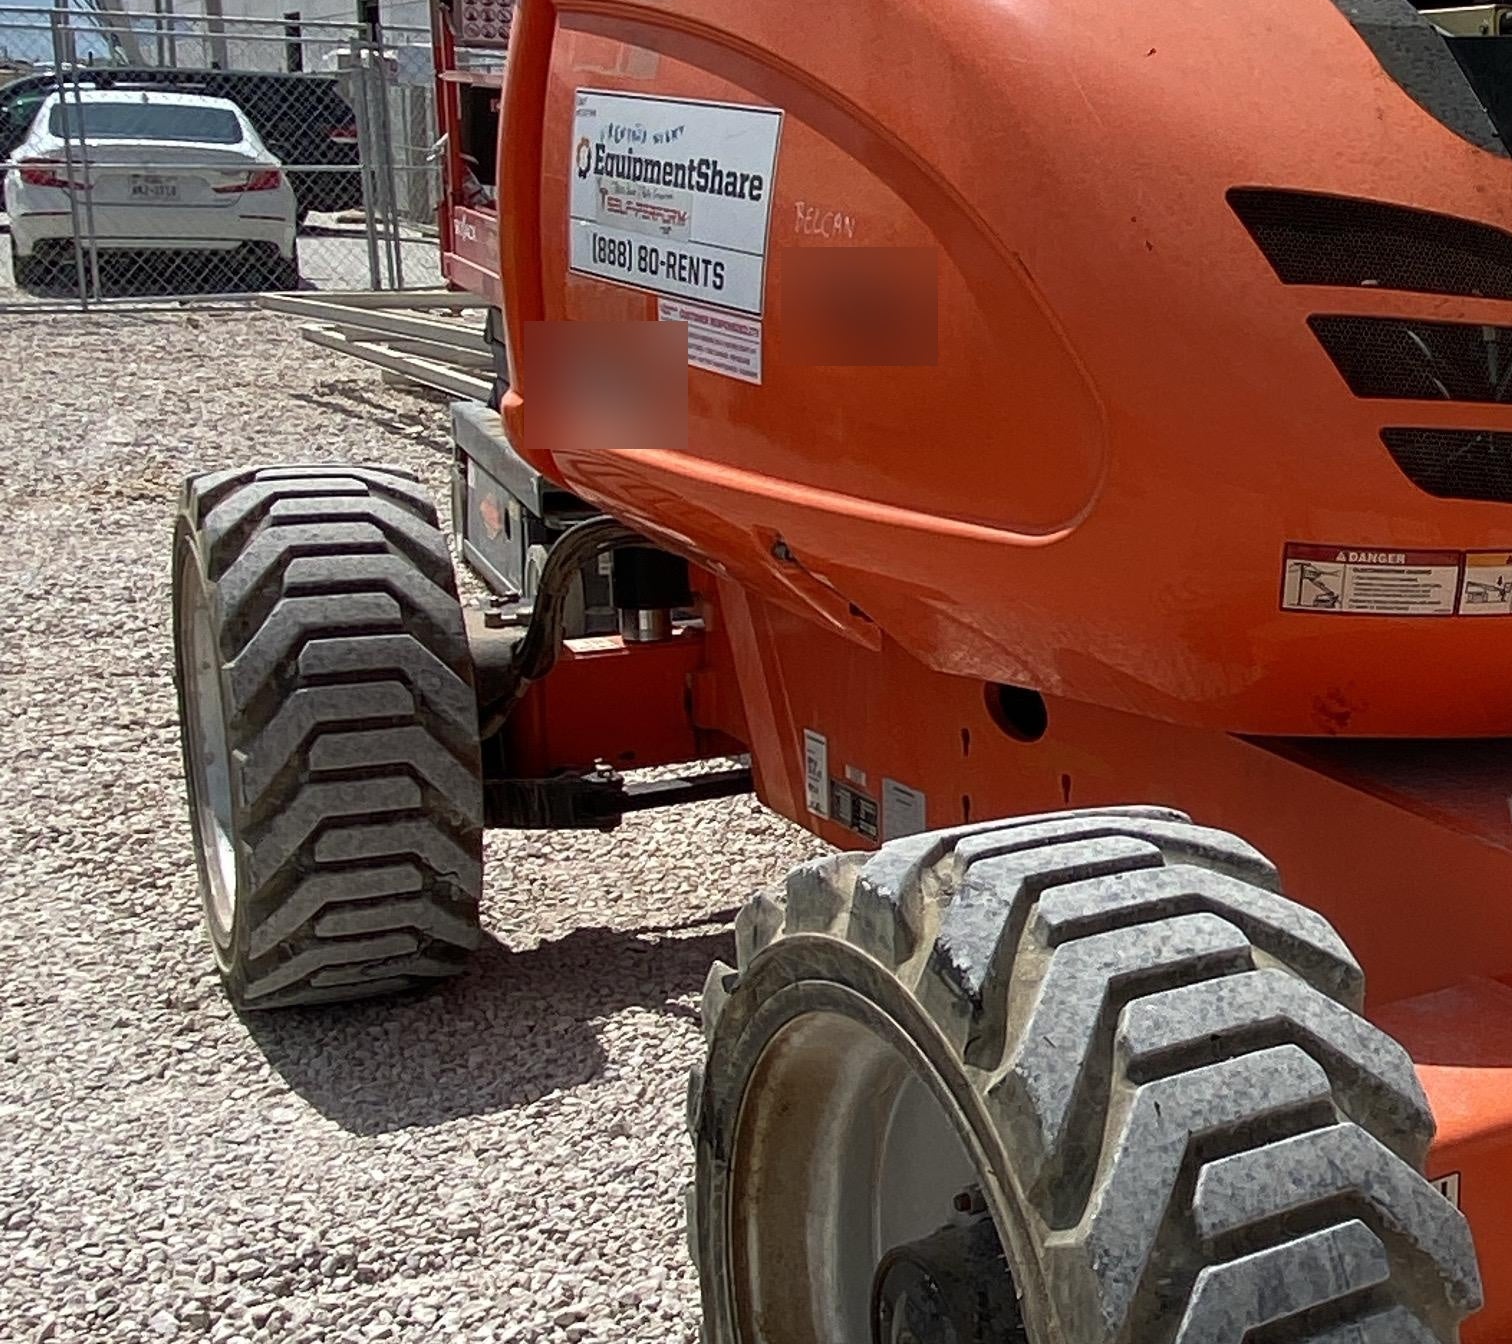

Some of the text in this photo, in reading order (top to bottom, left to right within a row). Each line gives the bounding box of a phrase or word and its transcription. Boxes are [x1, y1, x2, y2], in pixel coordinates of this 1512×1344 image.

[594, 142, 763, 202] EquipmentShare
[592, 232, 725, 291] (888) 80-RENTS
[1348, 551, 1406, 564] DANGER
